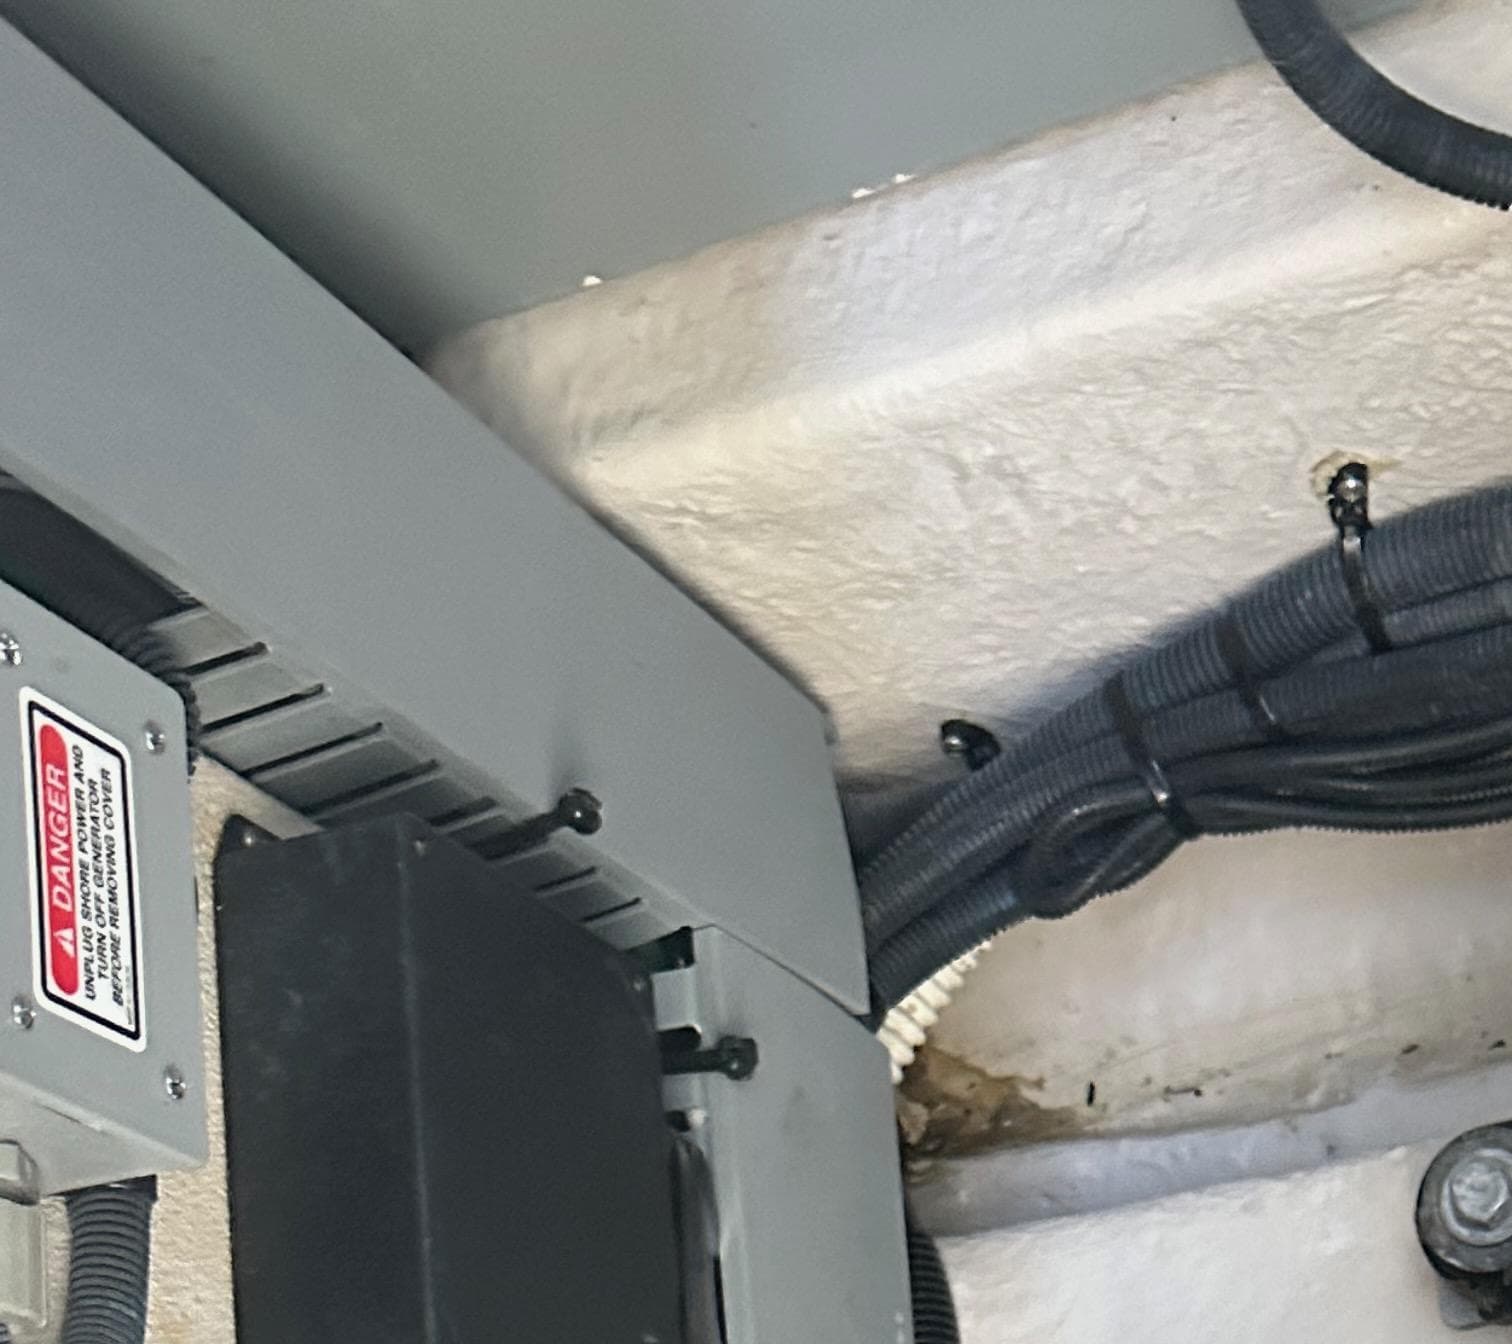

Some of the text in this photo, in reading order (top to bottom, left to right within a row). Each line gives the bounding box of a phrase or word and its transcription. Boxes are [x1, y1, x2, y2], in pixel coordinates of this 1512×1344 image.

[46, 762, 72, 912] DANGER
[72, 745, 96, 1000] UNPLUG SHORE POWER AND
[88, 779, 109, 979] TURN OFF GENERATOR
[101, 768, 123, 1006] BEFORE REMOVING COVER
